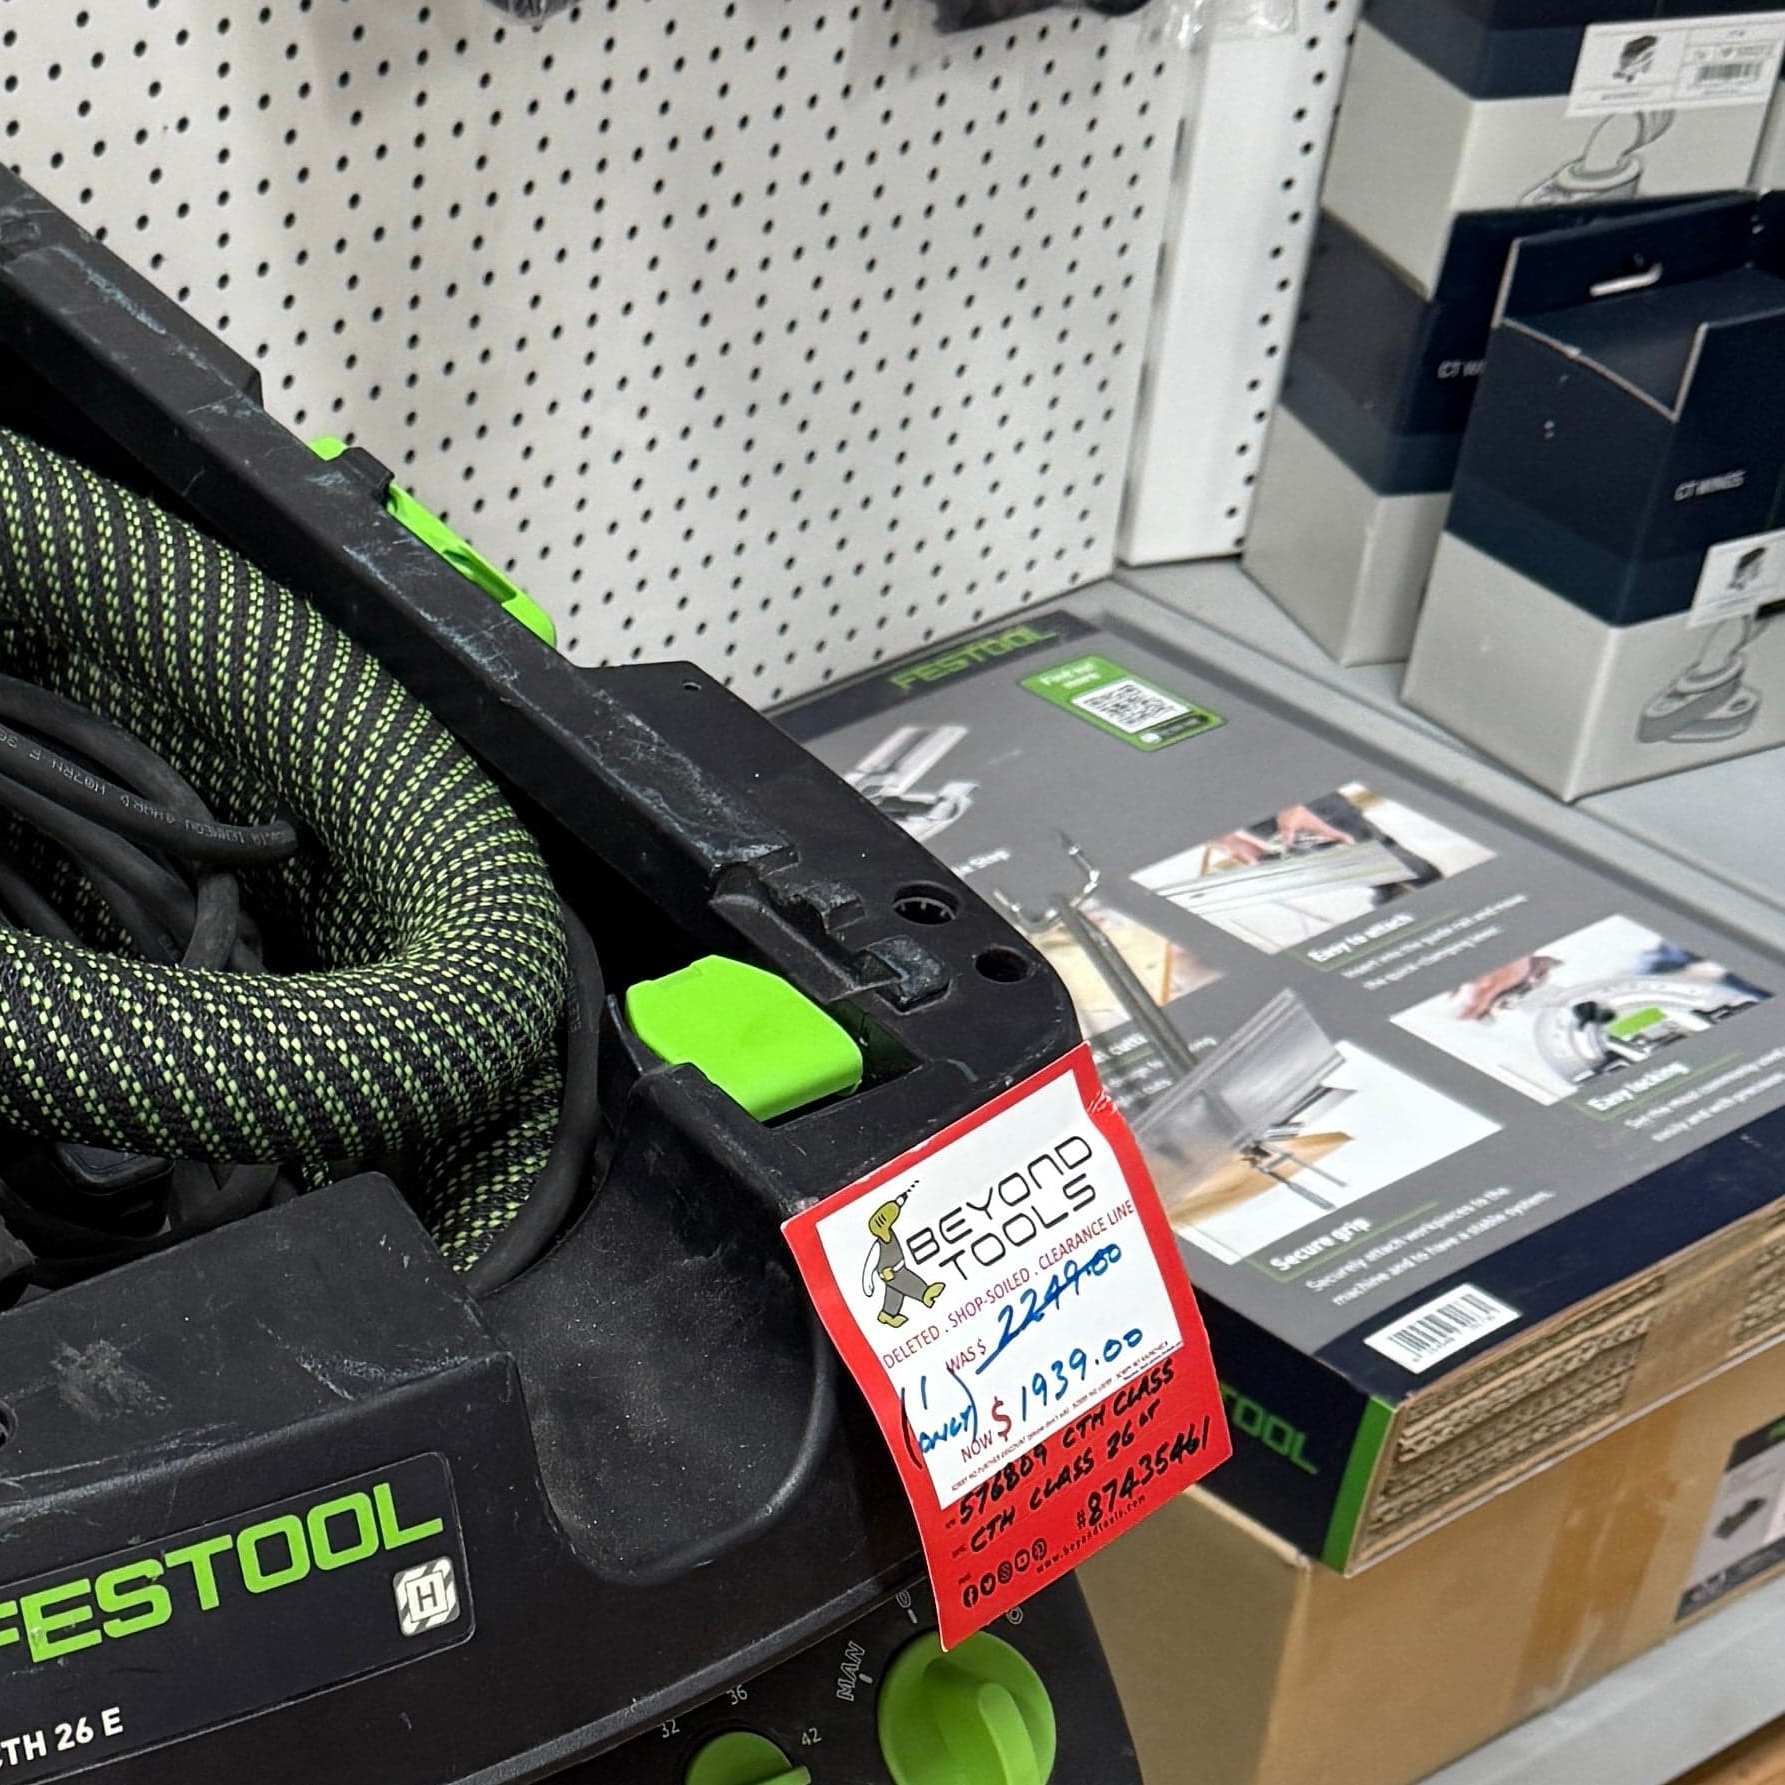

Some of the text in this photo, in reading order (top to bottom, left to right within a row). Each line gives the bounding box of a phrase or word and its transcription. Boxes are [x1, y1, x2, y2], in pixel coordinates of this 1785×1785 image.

[888, 626, 1059, 692] FESTOOL
[906, 1135, 1093, 1265] BEYOND
[939, 1172, 1097, 1281] TOOLS
[1269, 1216, 1374, 1272] Secure grip
[883, 1199, 1135, 1369] DELETED SHOP-SOILED CLEARANCE LINE
[948, 1346, 976, 1371] WAS
[1020, 1327, 1144, 1422] 1939.00
[960, 1395, 1013, 1463] NOW $
[1062, 1404, 1106, 1448] CTH
[1113, 1358, 1174, 1417] CLASS
[970, 1506, 1015, 1553] CTH
[1029, 1447, 1095, 1511] CLASS
[1106, 1420, 1134, 1460] 26
[726, 1684, 748, 1706] 36
[836, 1640, 866, 1702] MAN
[54, 1716, 95, 1753] 26
[101, 1706, 124, 1737] E
[661, 1718, 681, 1739] 32
[800, 1727, 823, 1747] 42
